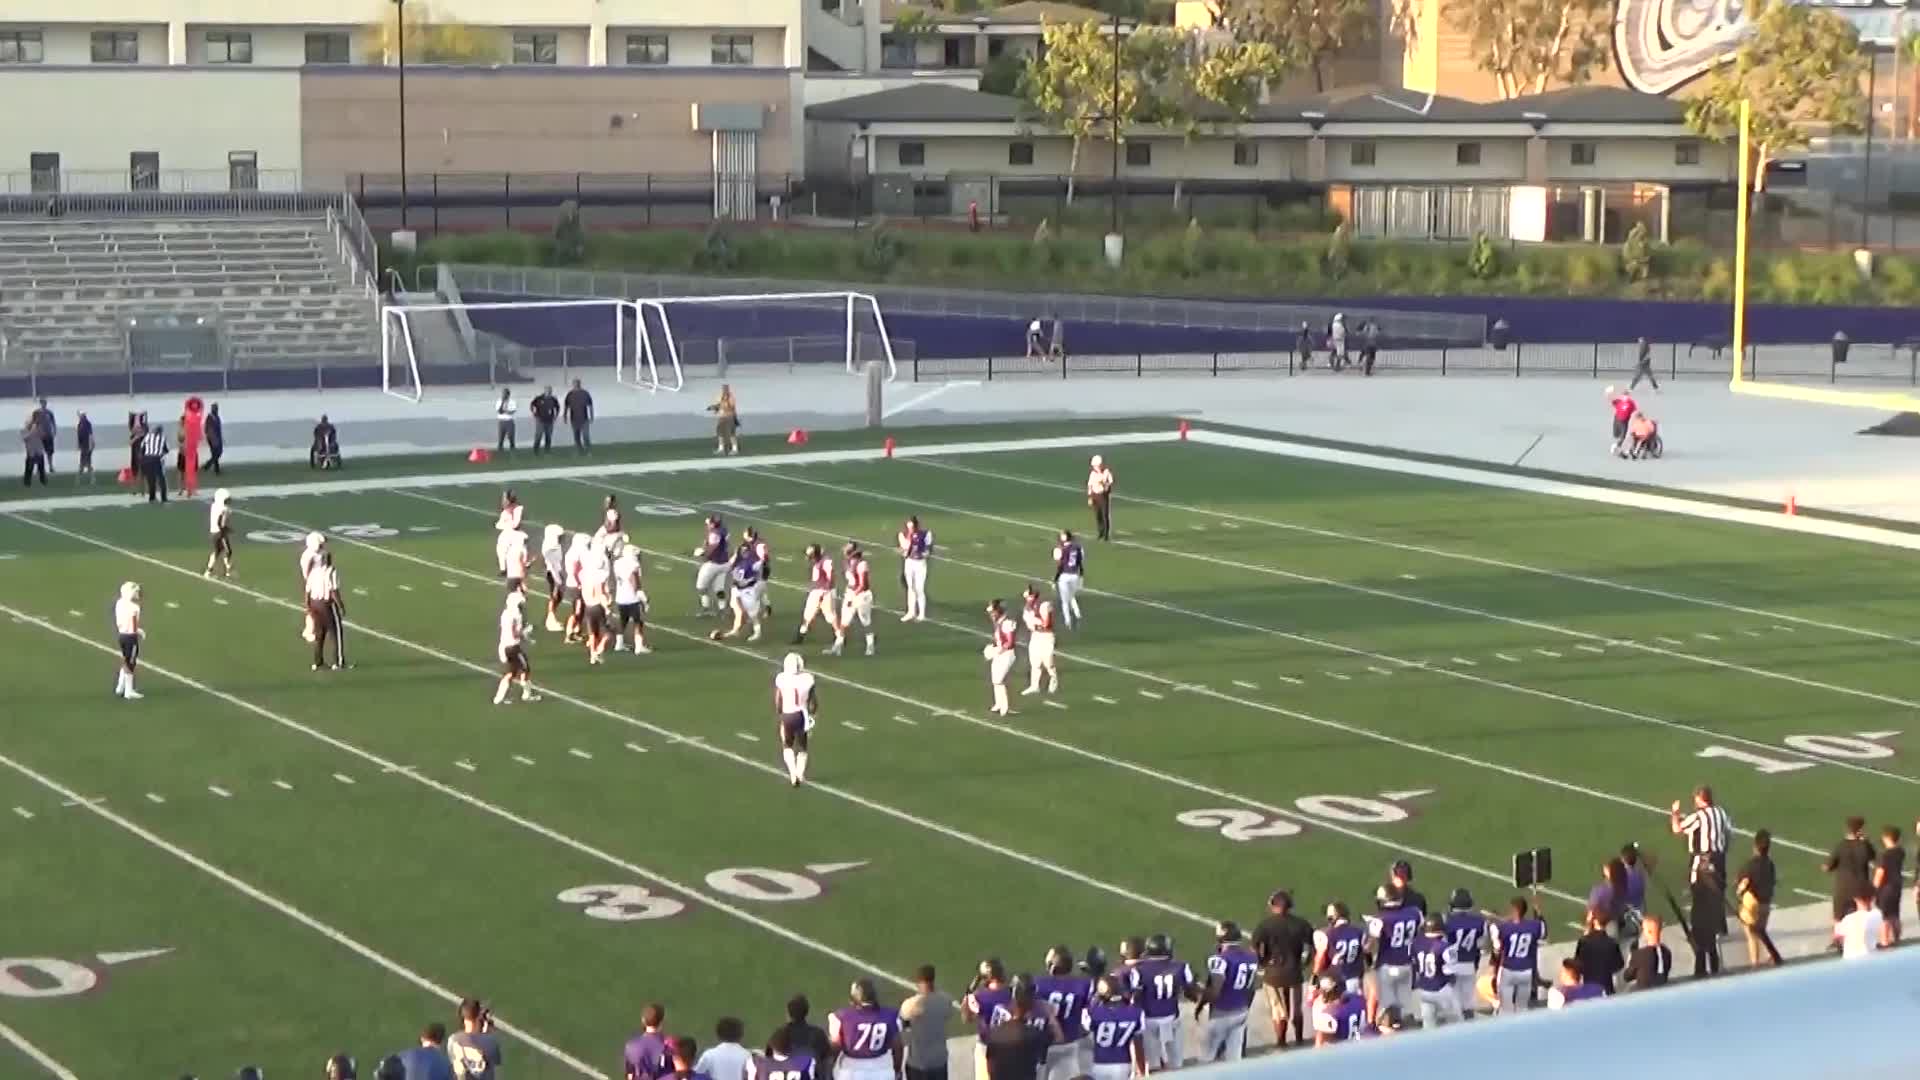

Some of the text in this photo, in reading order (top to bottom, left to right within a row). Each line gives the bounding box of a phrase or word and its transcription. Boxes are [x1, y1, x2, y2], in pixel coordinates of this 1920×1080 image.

[1695, 734, 1895, 773] 10
[1175, 794, 1408, 841] 20
[556, 868, 821, 920] 30
[1455, 928, 1477, 952] 14
[1508, 932, 1532, 958] 18
[1153, 974, 1174, 1000] 11
[853, 1022, 888, 1051] 78
[1096, 1021, 1136, 1048] 87
